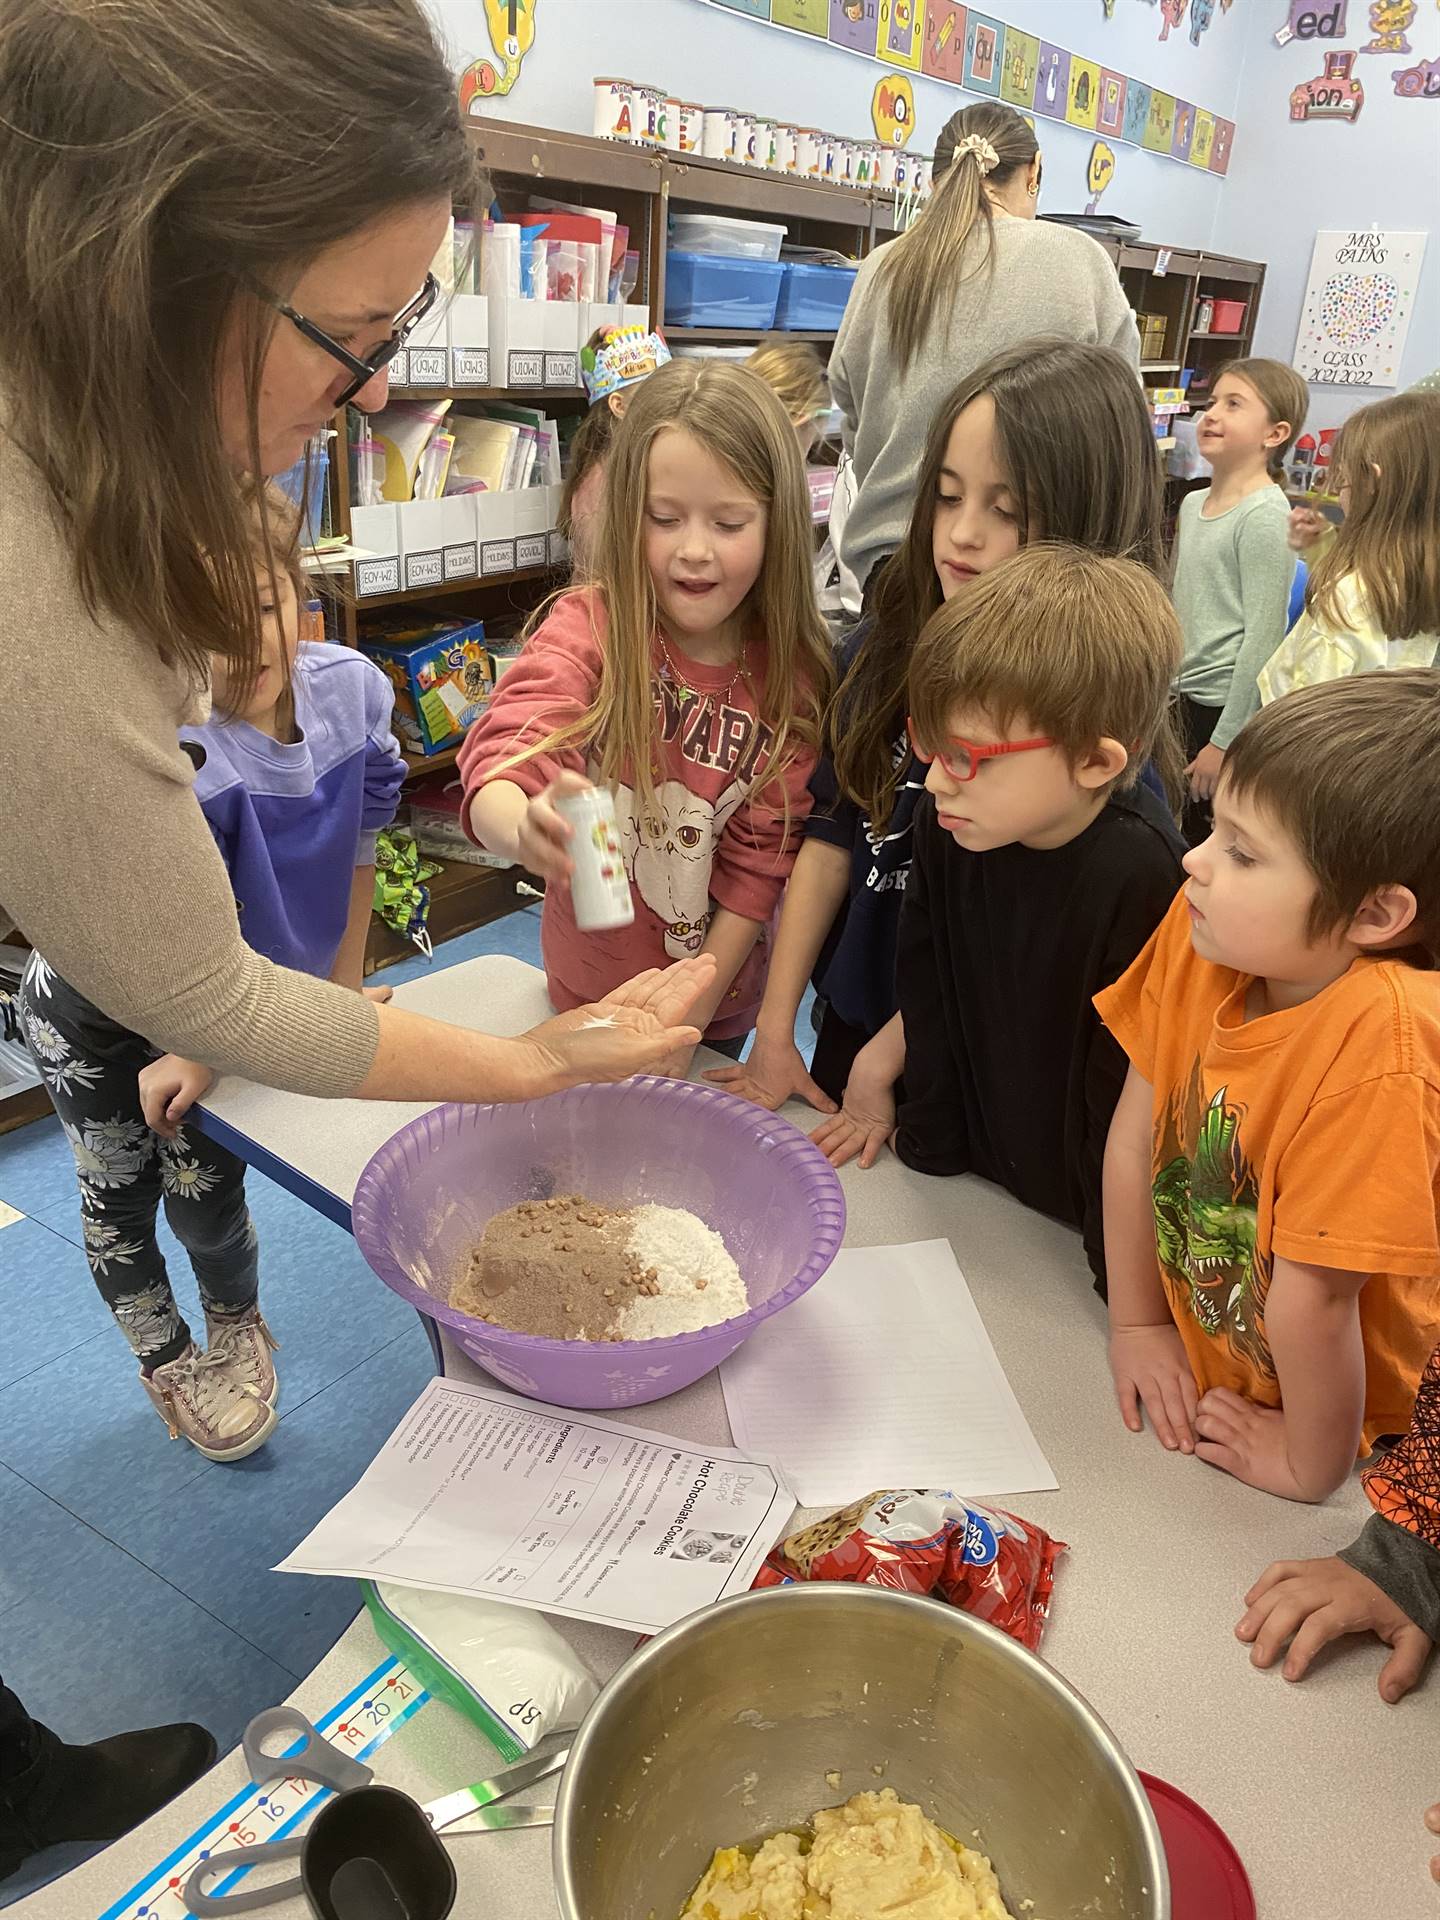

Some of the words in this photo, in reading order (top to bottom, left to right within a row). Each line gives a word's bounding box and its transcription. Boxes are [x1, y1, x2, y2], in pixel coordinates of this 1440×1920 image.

[1297, 3, 1341, 38] ed
[1306, 85, 1343, 107] ion
[616, 104, 631, 132] A
[1345, 233, 1384, 248] MRS
[1323, 351, 1367, 367] CLASS
[416, 360, 439, 374] U9W2
[460, 360, 483, 374] U9W3
[514, 362, 538, 375] U10W1
[364, 569, 392, 584] EOY-W2
[411, 562, 438, 577] EOY-W3
[483, 1430, 495, 1440] cups
[519, 1433, 529, 1442] cup
[533, 1430, 542, 1439] cup
[544, 1433, 553, 1442] cup
[544, 1424, 573, 1464] Ingredients
[589, 1445, 600, 1456] Prep
[582, 1456, 594, 1469] Time
[698, 1460, 715, 1478] Hot
[563, 1490, 575, 1502] Cook
[674, 1479, 707, 1525] Chocolate
[555, 1503, 568, 1514] Time
[653, 1525, 683, 1556] Cookies
[394, 1681, 413, 1700] 21
[366, 1702, 391, 1726] 20
[509, 1698, 542, 1725] BP
[343, 1726, 366, 1746] 19
[262, 1802, 285, 1822] 16
[232, 1830, 257, 1848] 15
